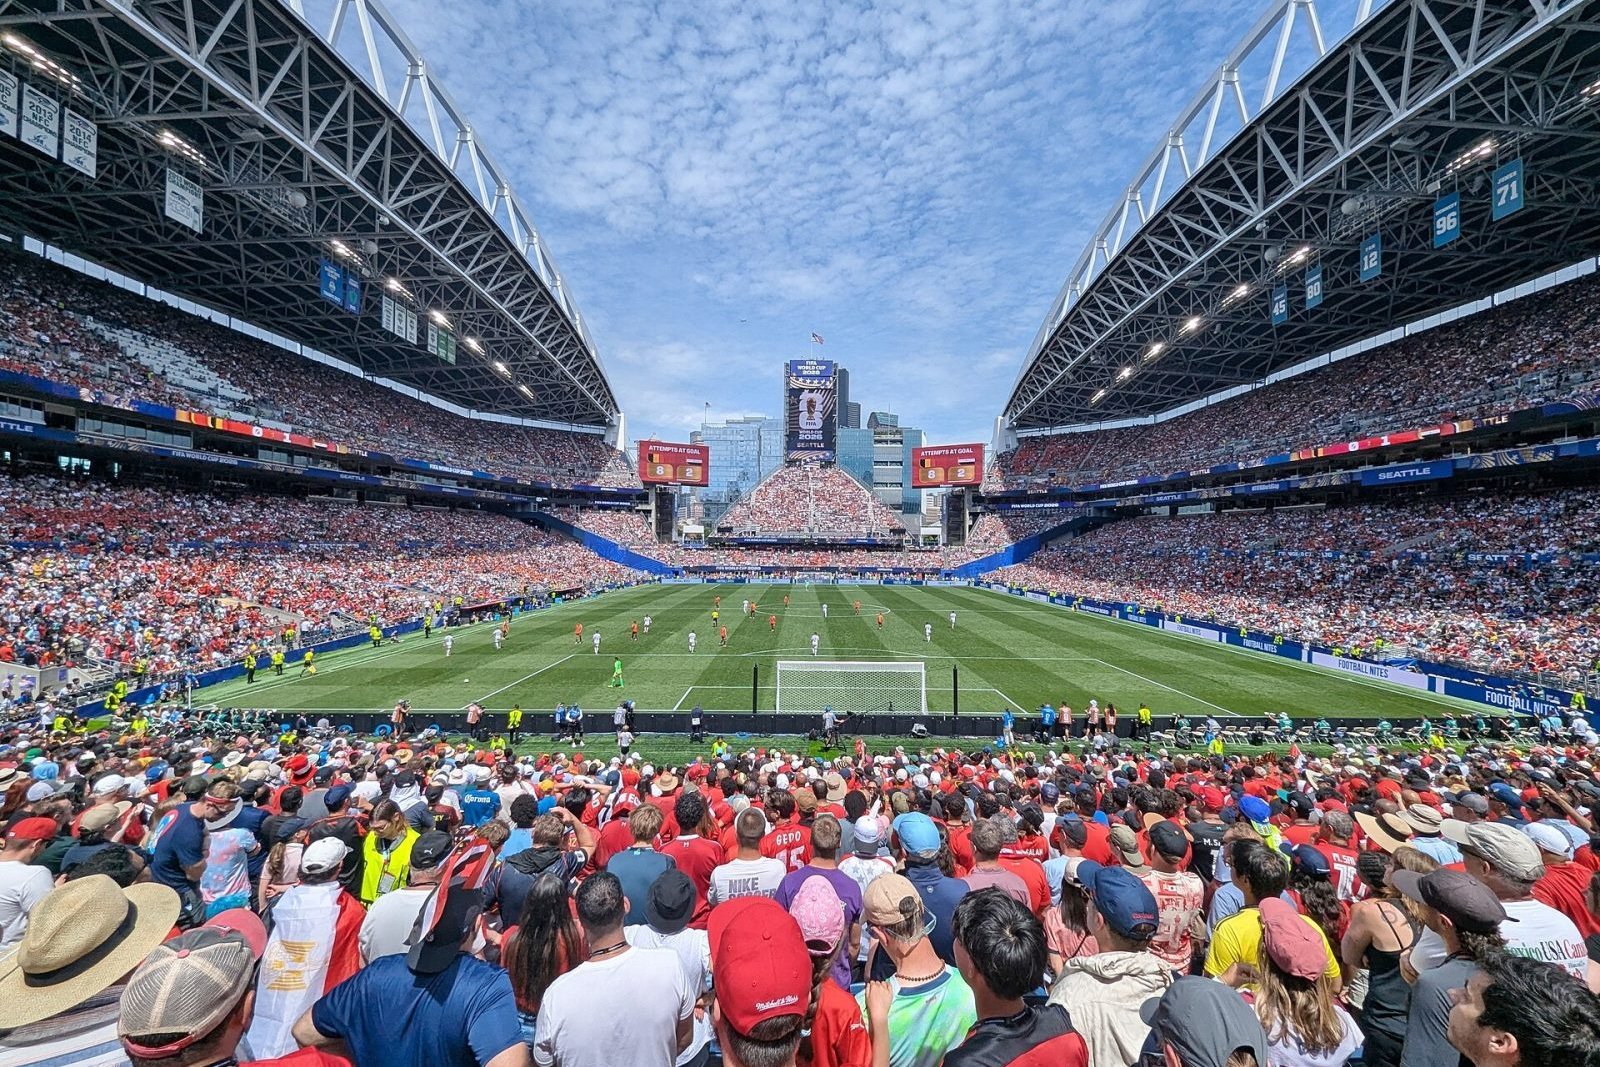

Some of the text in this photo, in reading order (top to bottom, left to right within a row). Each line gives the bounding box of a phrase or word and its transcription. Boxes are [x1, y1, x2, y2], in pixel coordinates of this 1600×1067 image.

[29, 101, 53, 121] 2013
[31, 112, 50, 127] NFC
[69, 124, 92, 143] 2014
[72, 134, 89, 149] NFC
[1497, 180, 1519, 207] 71
[1436, 211, 1457, 236] 96
[1363, 250, 1378, 271] 12
[1307, 281, 1320, 300] 80
[1272, 299, 1286, 316] 45
[0, 422, 34, 433] TTLE
[172, 450, 186, 458] FIFA
[186, 452, 207, 461] WORLD
[208, 454, 219, 462] CUP
[648, 445, 678, 453] ATTEMPTS
[920, 449, 949, 457] ATTEMPTS
[656, 465, 664, 475] 8
[685, 467, 693, 477] 2
[927, 470, 936, 479] 8
[957, 468, 965, 478] 2
[1190, 468, 1210, 477] SEATTLE
[1378, 467, 1431, 480] SEATTLE
[1243, 638, 1277, 653] FOOTBALL NITES
[1338, 659, 1389, 678] FOOTBALL NITES
[1485, 690, 1532, 712] FOOTBALL
[464, 794, 491, 804] Corona
[776, 830, 801, 846] GEDO
[776, 845, 805, 873] 15
[728, 877, 759, 893] NIKE
[1539, 940, 1567, 961] USA
